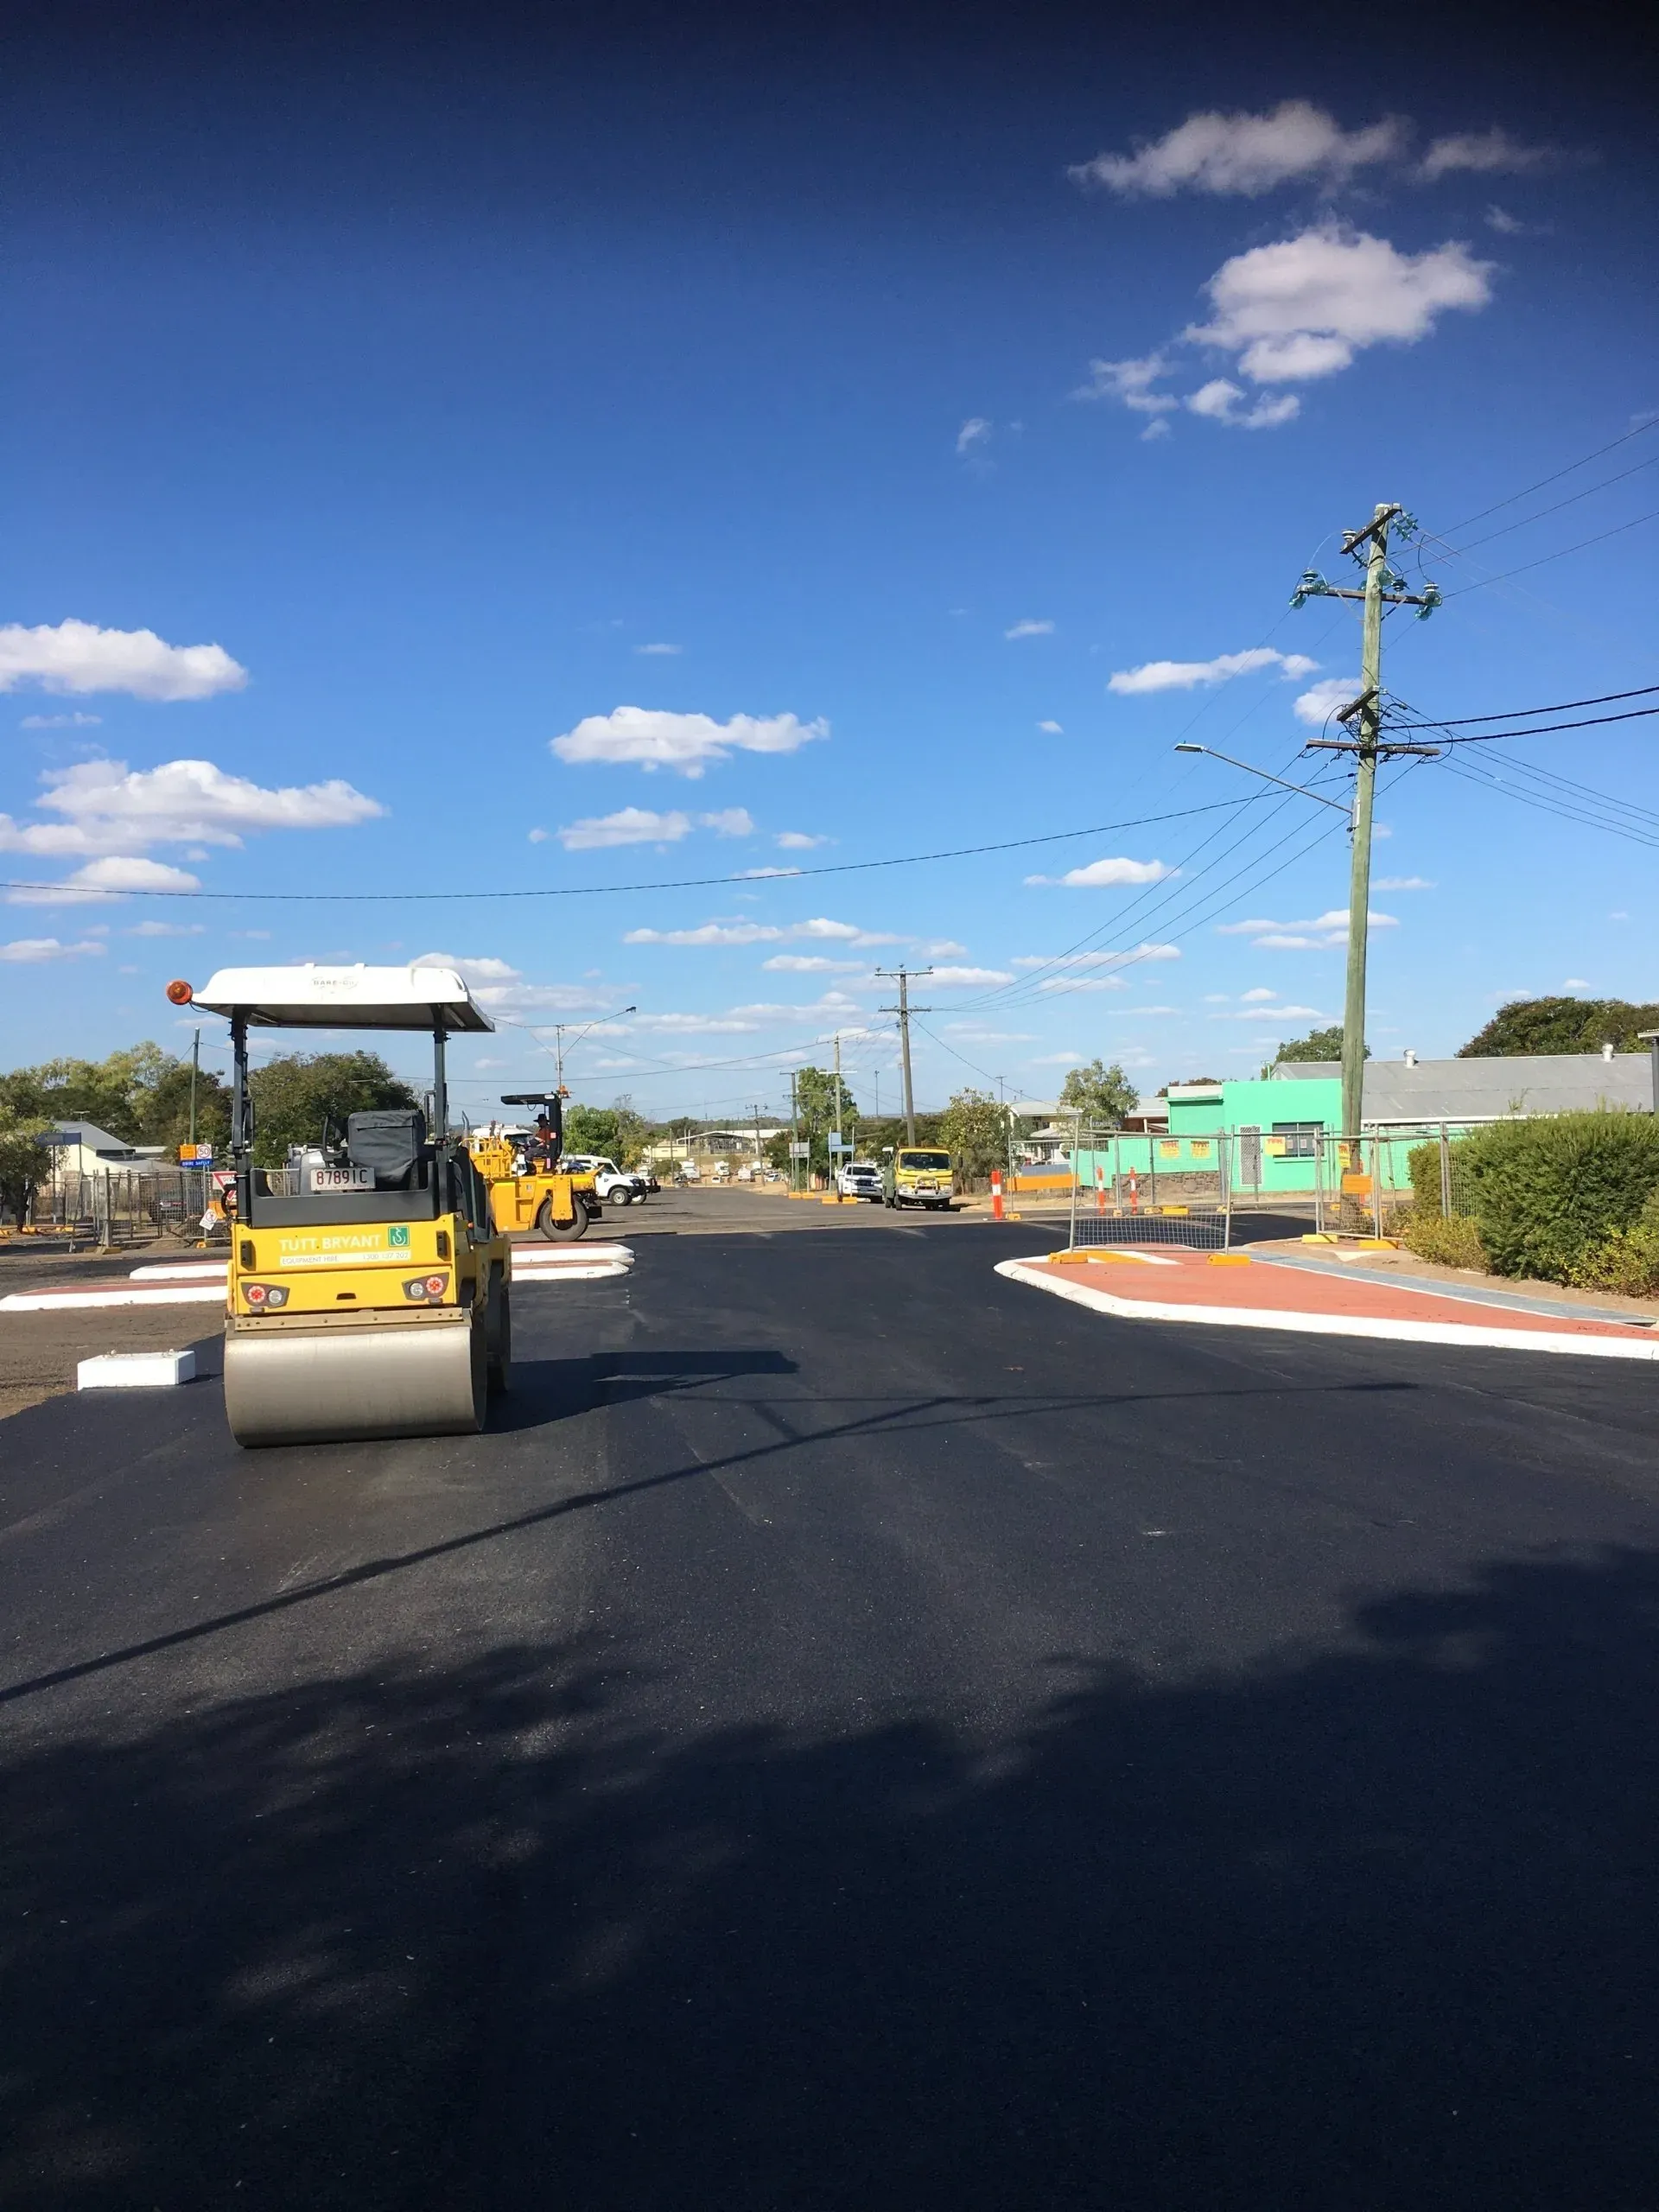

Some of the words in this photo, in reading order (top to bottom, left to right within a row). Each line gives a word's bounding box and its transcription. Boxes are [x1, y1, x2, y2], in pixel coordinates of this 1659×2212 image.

[279, 1237, 317, 1251] TUTT
[322, 1235, 381, 1249] BRYANT
[282, 1255, 322, 1265] EQUIPMENT
[323, 1255, 339, 1263] HIRE
